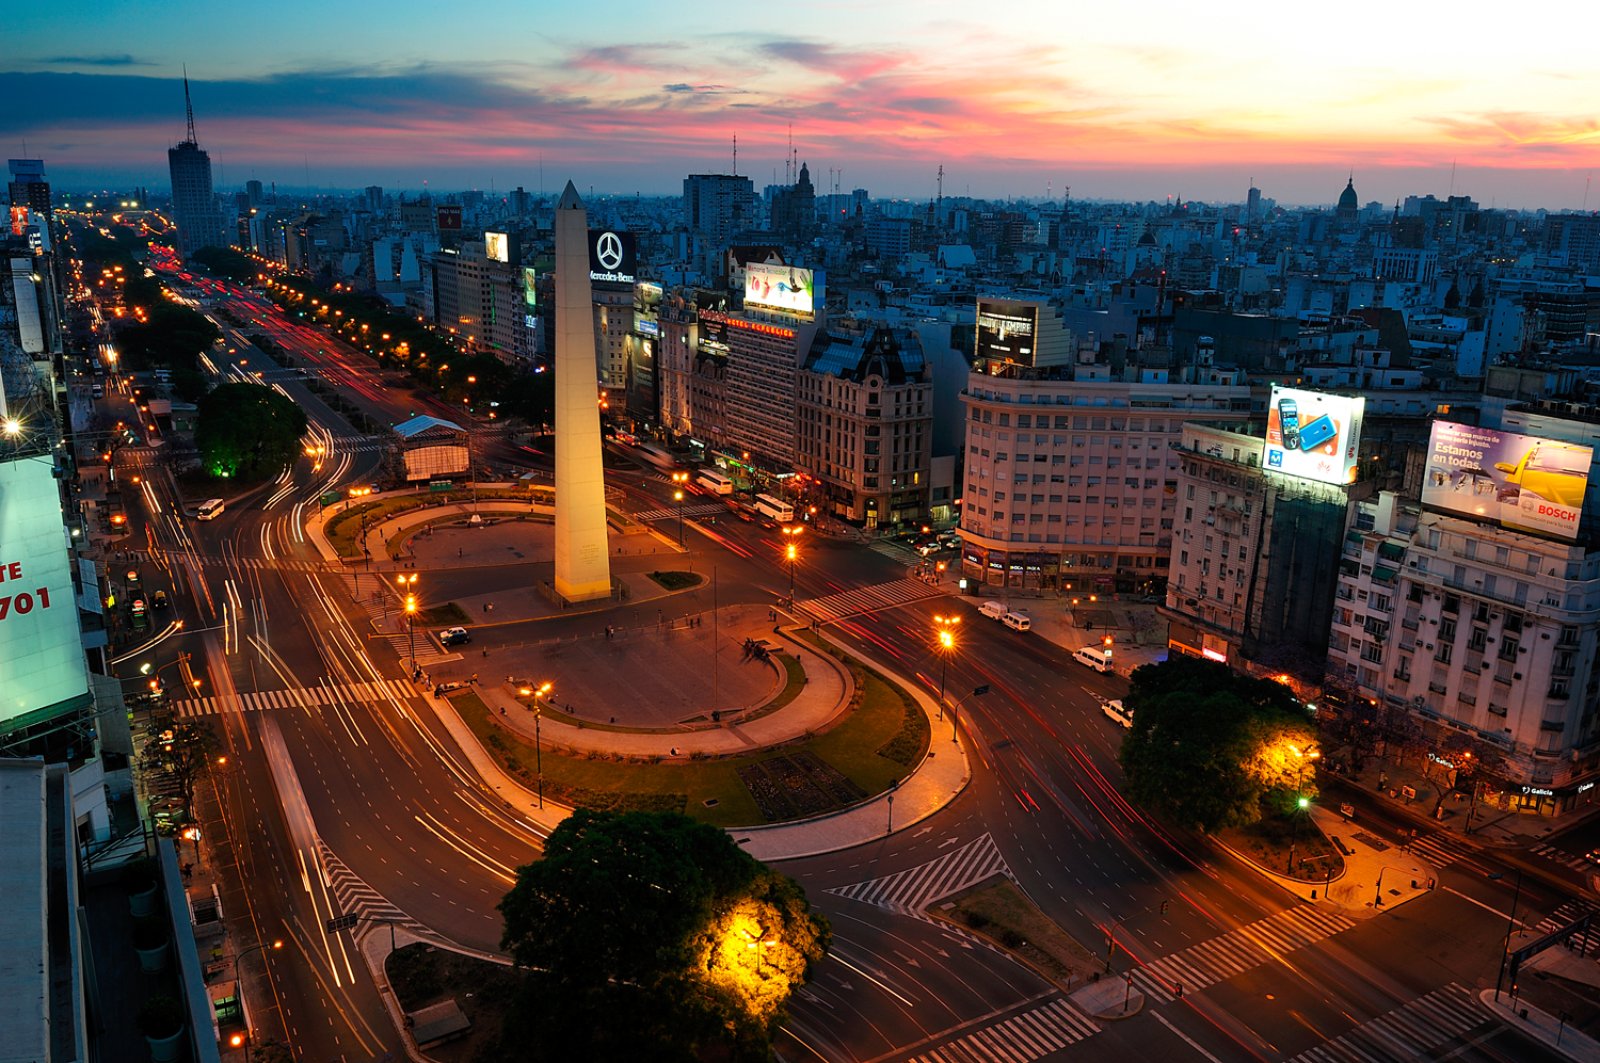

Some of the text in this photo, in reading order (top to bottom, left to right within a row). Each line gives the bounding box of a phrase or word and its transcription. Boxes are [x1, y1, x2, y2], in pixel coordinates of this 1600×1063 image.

[1473, 434, 1491, 442] marca
[1435, 442, 1483, 460] Estamos
[1433, 455, 1482, 471] en todas.
[1538, 504, 1576, 522] BOSCH
[0, 587, 50, 621] 701
[1531, 788, 1553, 796] Galicia
